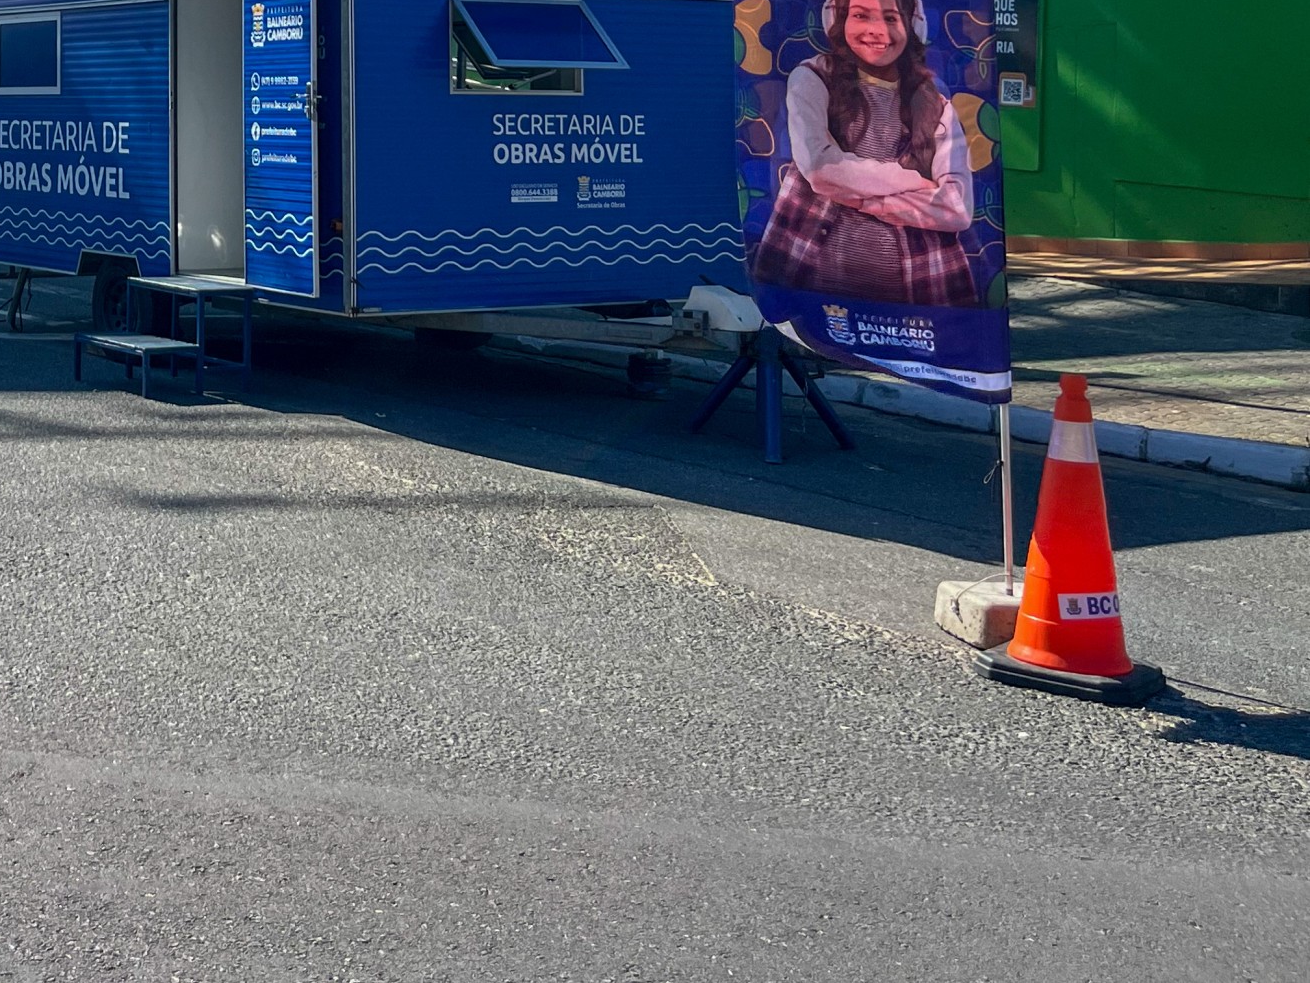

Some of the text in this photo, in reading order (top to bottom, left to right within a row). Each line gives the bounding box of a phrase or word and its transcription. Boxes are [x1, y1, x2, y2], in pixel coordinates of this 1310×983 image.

[267, 15, 303, 28] BALNEÁRIO
[267, 27, 303, 41] CAMBORIÚ
[493, 114, 645, 135] SECRETARIA DE
[103, 121, 130, 154] DE
[493, 137, 643, 164] OBRAS MÓVEL
[57, 155, 130, 199] MÓVEL
[855, 313, 934, 328] PREFEITURA
